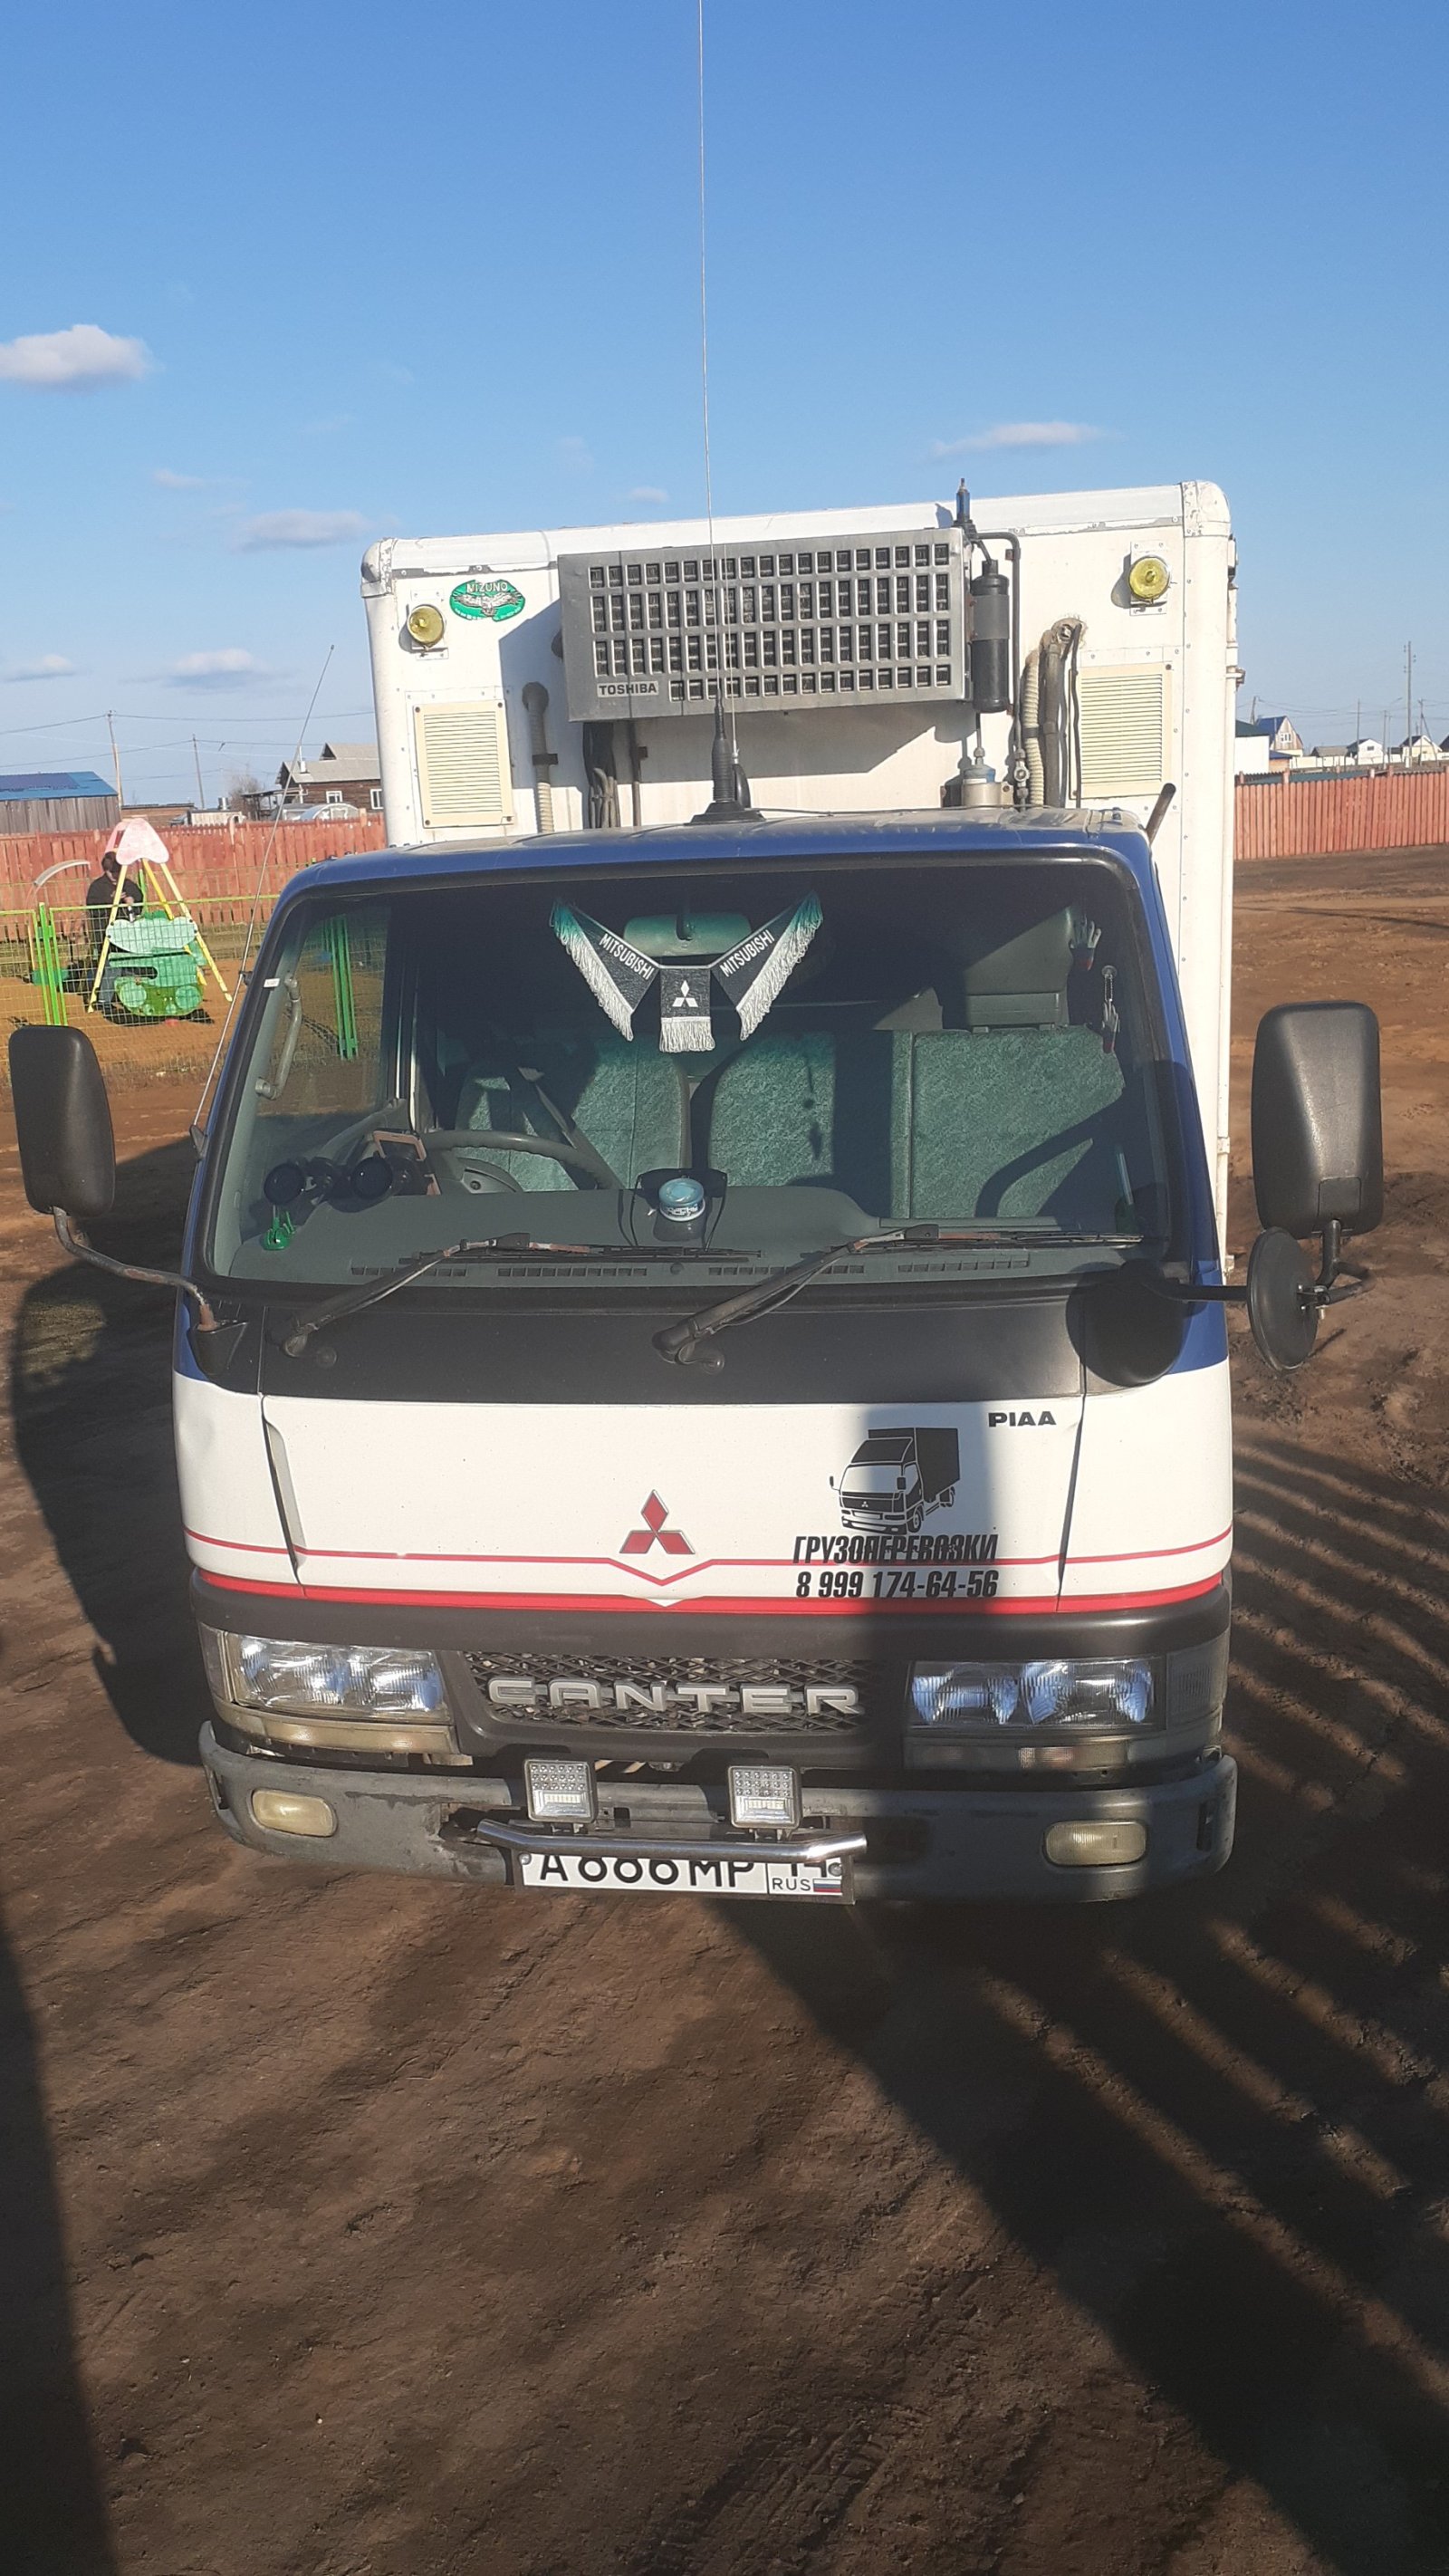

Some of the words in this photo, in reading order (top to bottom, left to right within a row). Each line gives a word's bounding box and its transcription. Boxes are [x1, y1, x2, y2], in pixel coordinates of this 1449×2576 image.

[466, 582, 507, 593] MIZUNO
[599, 683, 657, 695] TOSHIBA
[599, 933, 655, 980] MITSUBISHI
[719, 929, 774, 977] MITSUBISHI
[988, 1411, 1057, 1427] PIAA
[792, 1534, 998, 1564] ГРУЗОПЕРЕВОЗКИ
[796, 1571, 811, 1598] 8
[818, 1571, 864, 1598] 999
[872, 1570, 999, 1599] 174-64-56
[487, 1677, 864, 1714] CANTER
[772, 1877, 811, 1891] RUS
